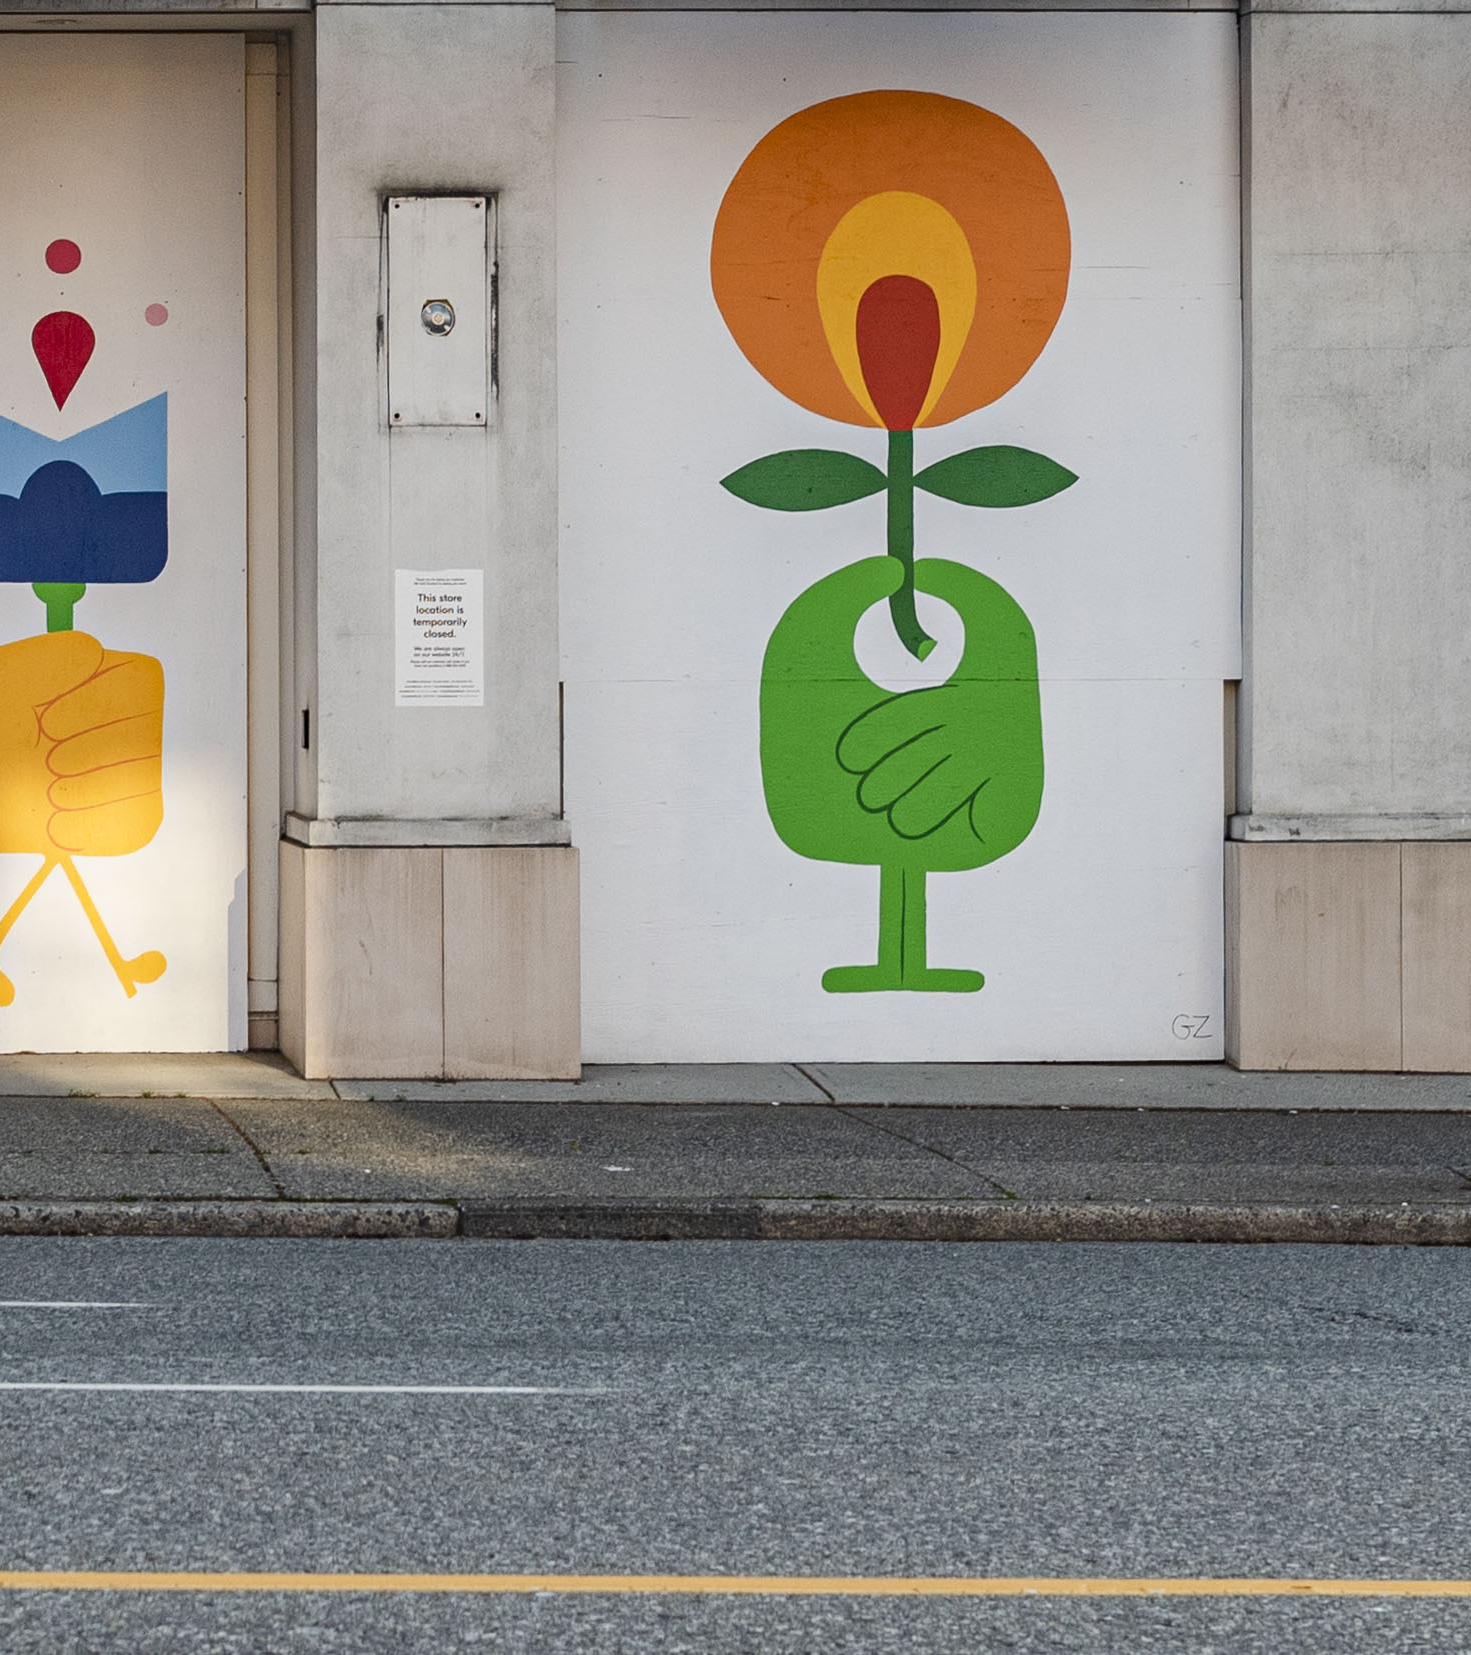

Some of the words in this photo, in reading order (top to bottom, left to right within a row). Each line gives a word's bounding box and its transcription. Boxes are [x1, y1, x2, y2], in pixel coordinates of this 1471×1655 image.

[417, 593, 436, 602] This
[439, 593, 463, 602] store
[416, 605, 454, 614] location
[457, 605, 464, 614] is
[413, 617, 467, 628] temporarily
[423, 629, 457, 638] closed.
[1171, 1013, 1213, 1040] GZ
